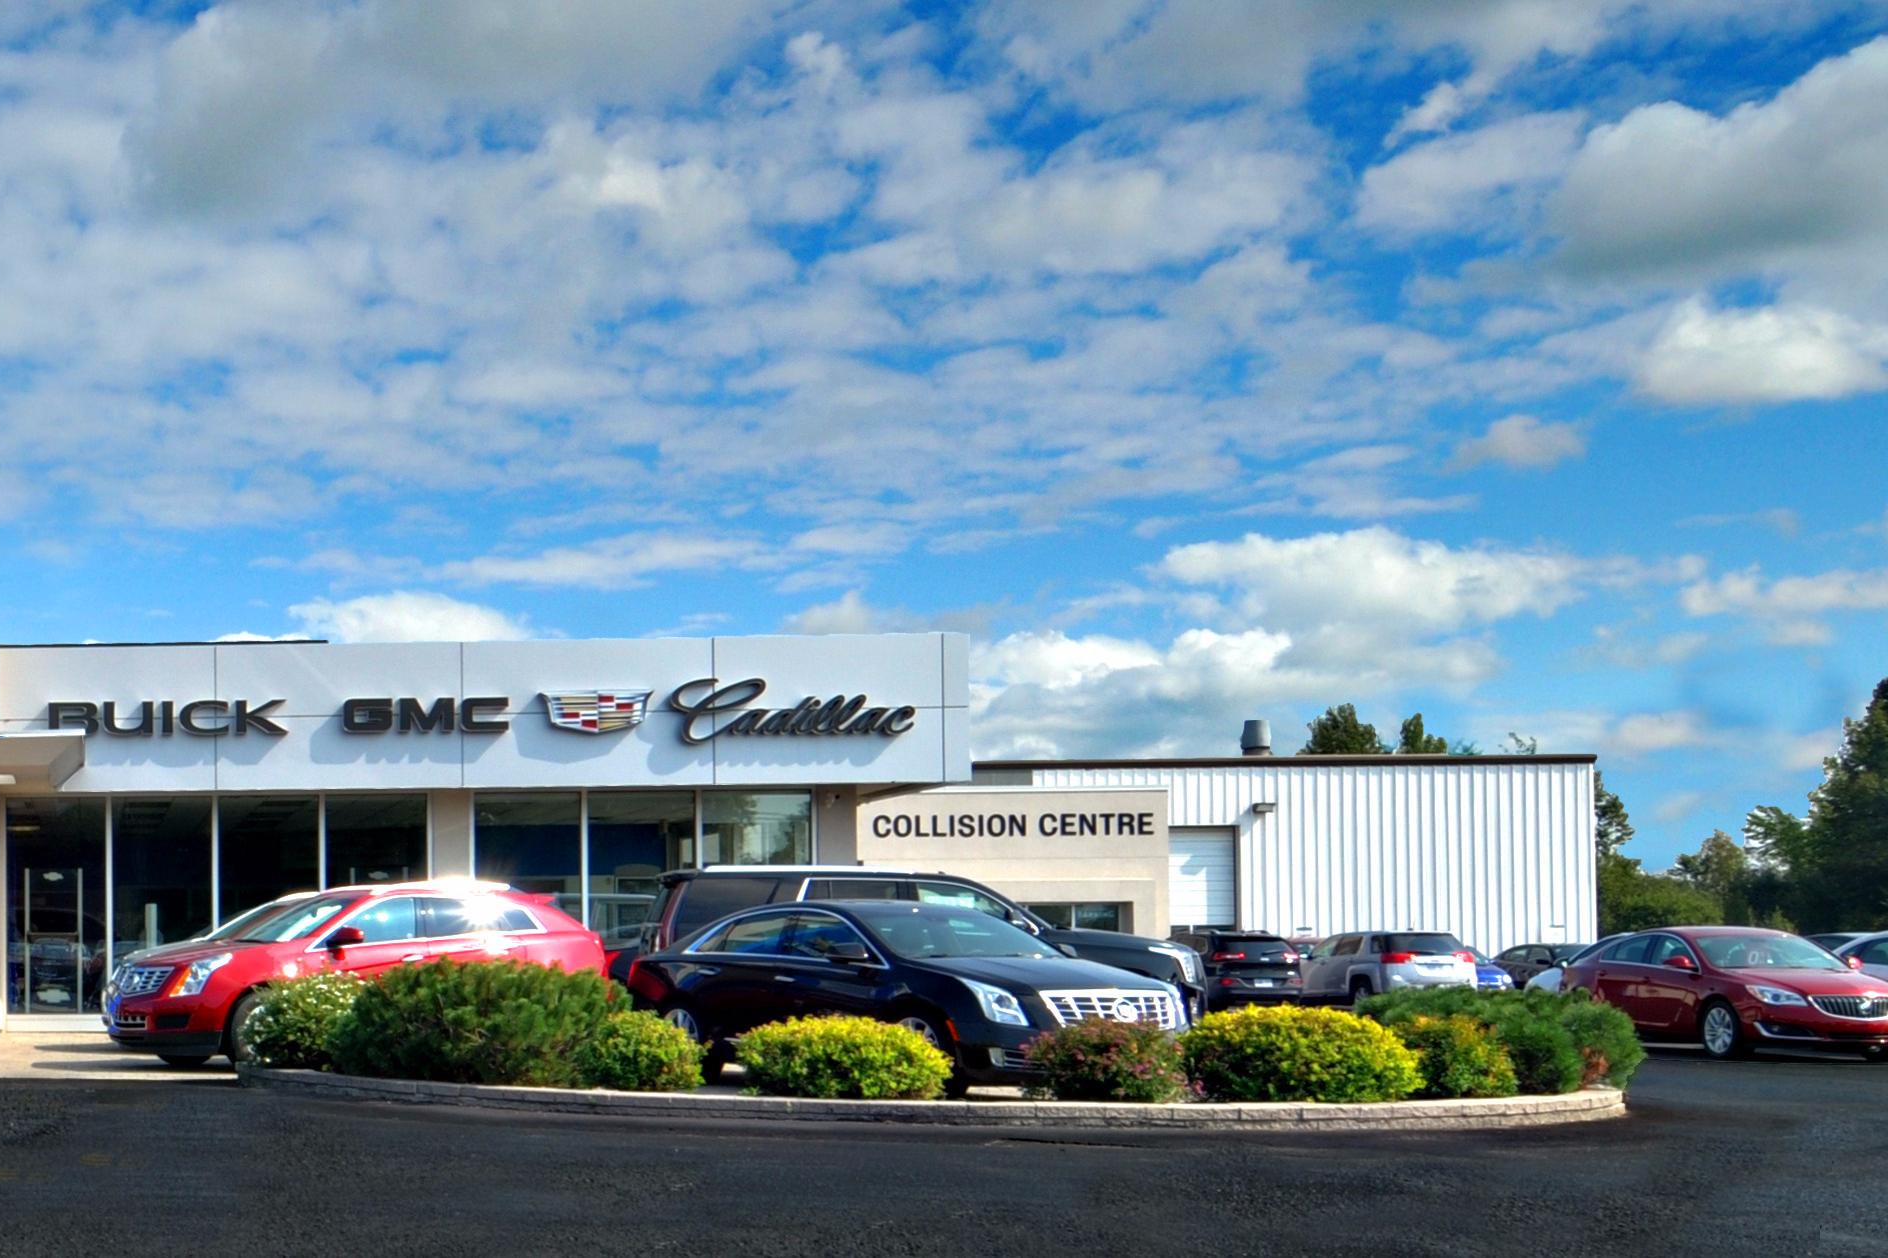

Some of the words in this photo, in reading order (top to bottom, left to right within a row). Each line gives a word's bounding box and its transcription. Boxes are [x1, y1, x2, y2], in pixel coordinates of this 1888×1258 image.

[47, 698, 290, 736] BUICK
[342, 696, 510, 734] GMC
[670, 677, 916, 745] Cadillac
[872, 814, 1027, 838] COLLISION
[1038, 813, 1155, 837] CENTRE
